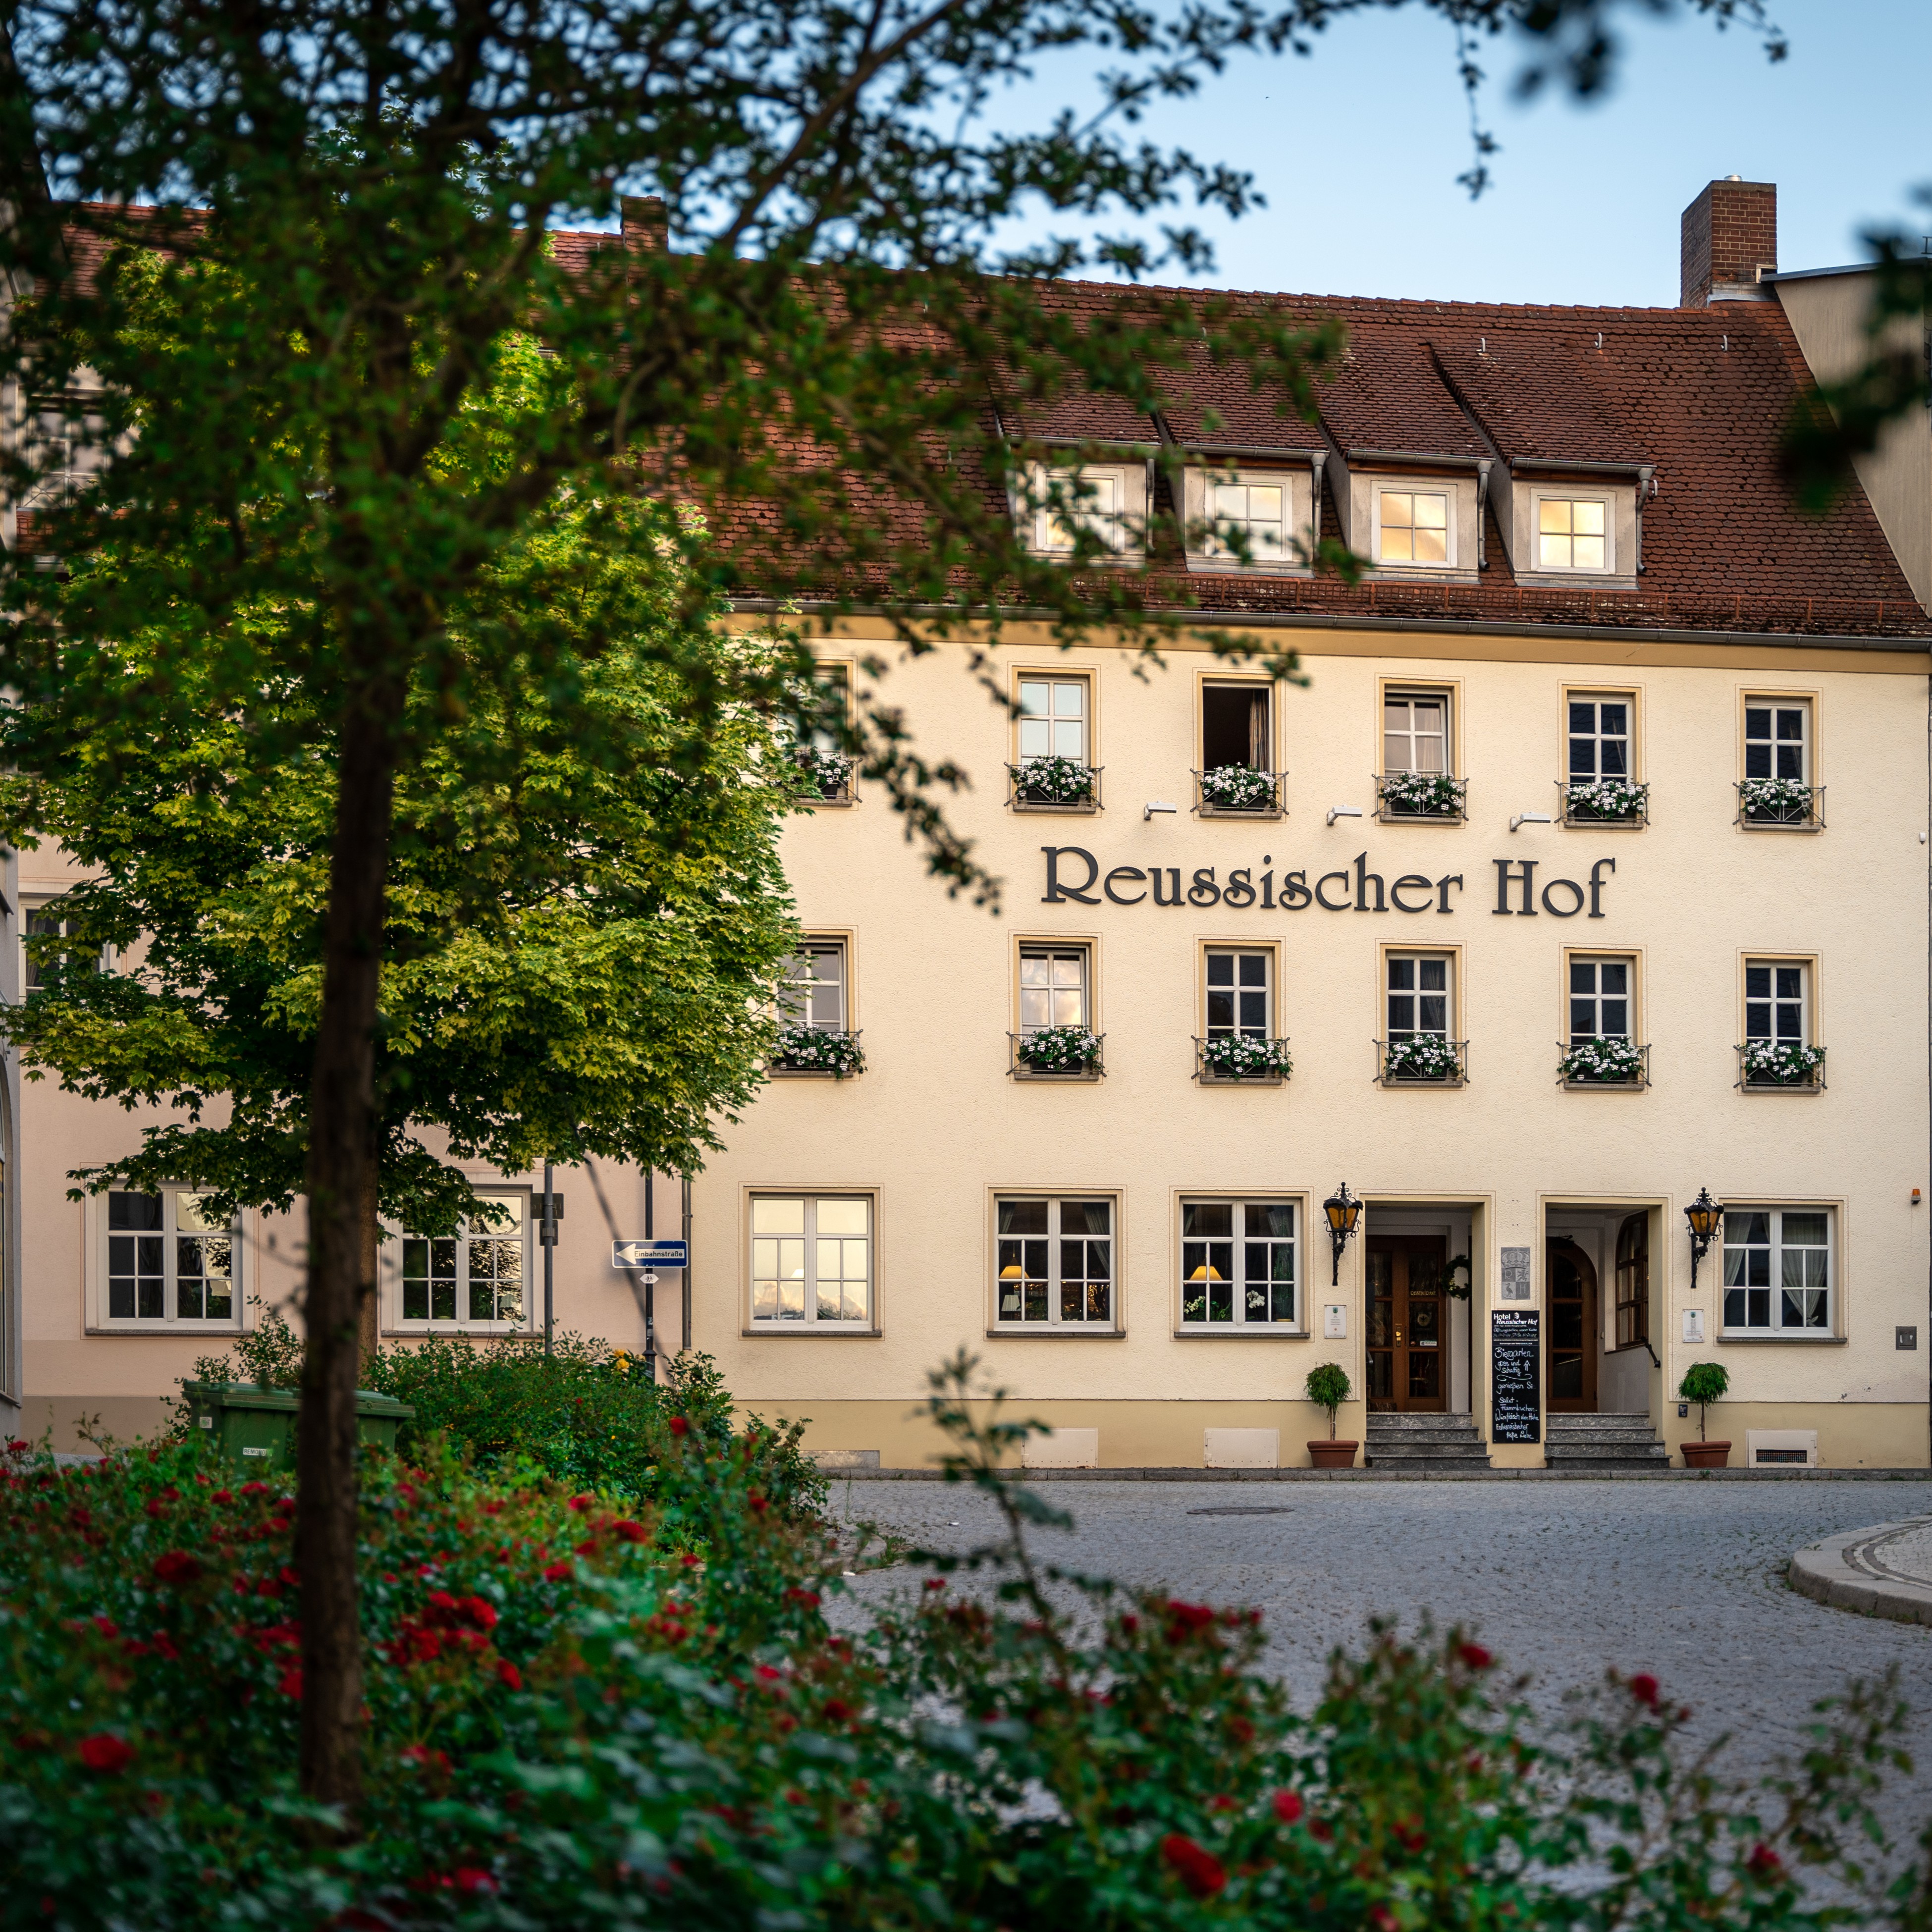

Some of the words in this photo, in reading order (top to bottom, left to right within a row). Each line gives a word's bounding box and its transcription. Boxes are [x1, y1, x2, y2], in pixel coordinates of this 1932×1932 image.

[1041, 846, 1463, 912] Reussischer
[1492, 858, 1615, 917] Hof
[1495, 1347, 1534, 1360] Biergarten
[1496, 1382, 1524, 1394] genießen
